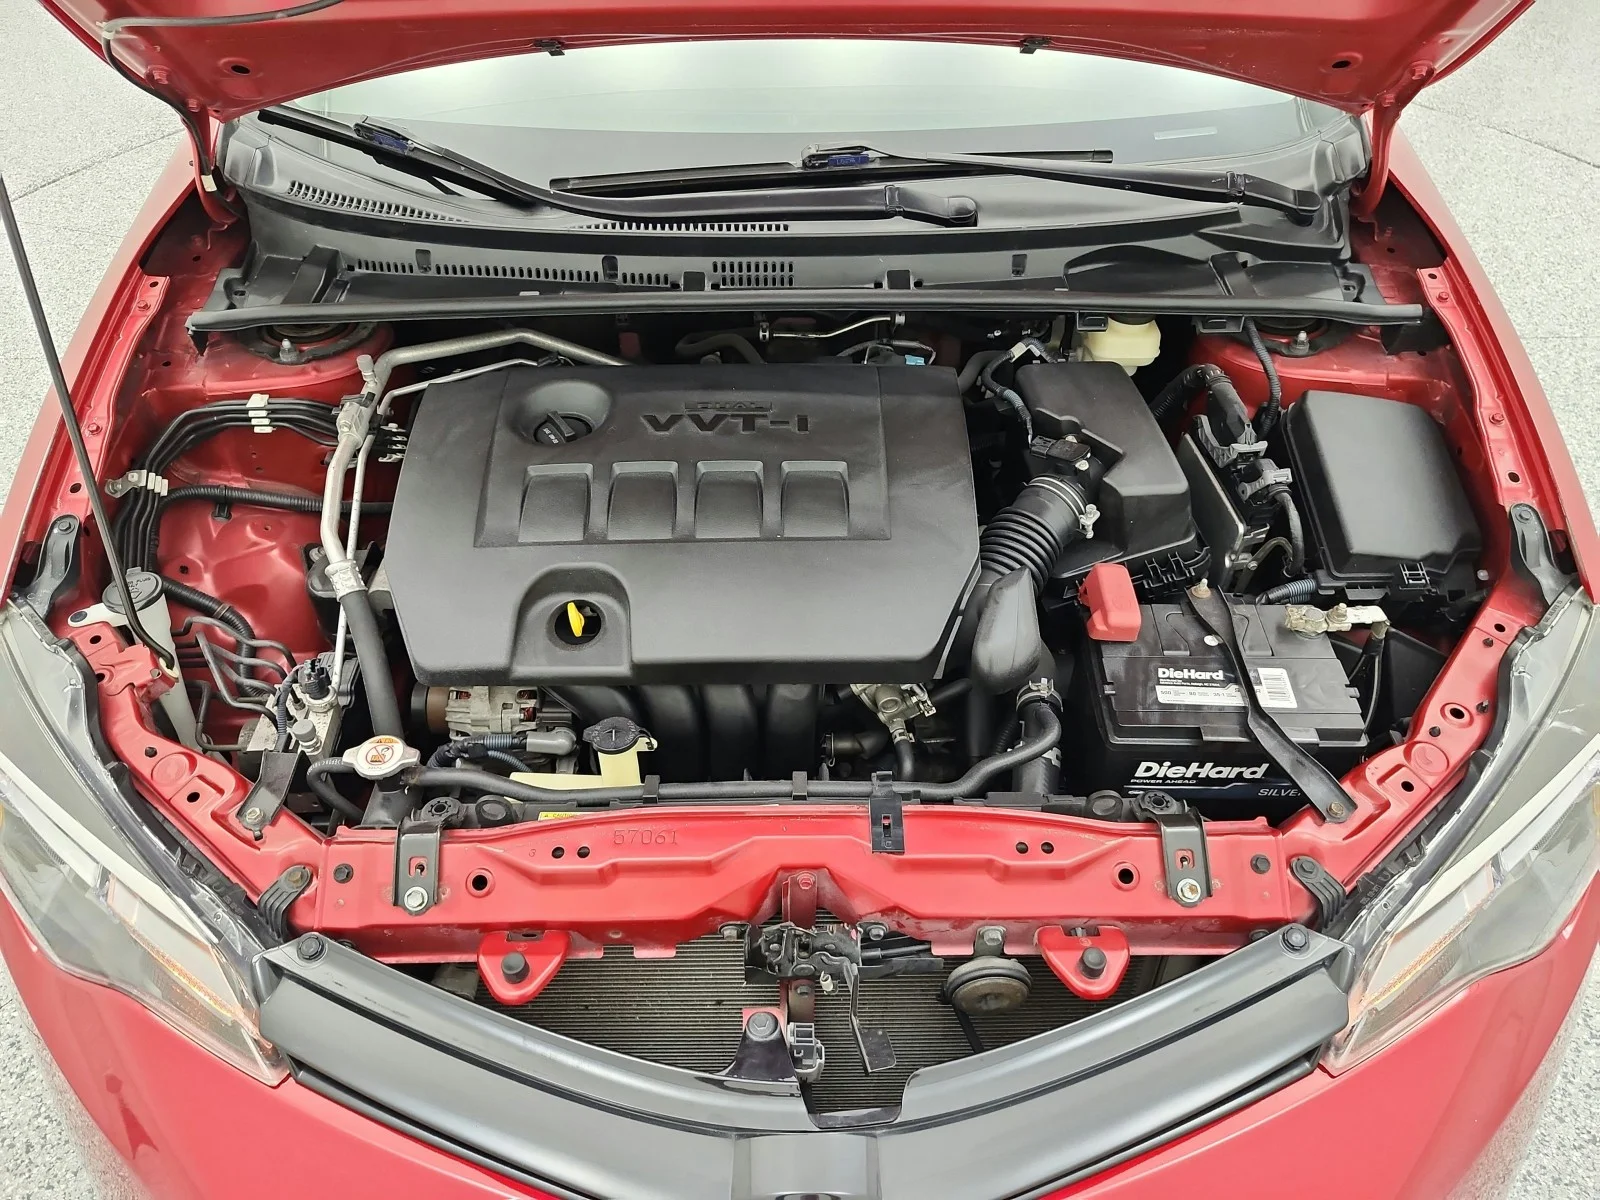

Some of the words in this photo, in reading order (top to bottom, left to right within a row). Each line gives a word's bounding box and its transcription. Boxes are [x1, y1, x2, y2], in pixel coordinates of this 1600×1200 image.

[1157, 667, 1225, 681] DieHard
[1134, 761, 1270, 779] DieHard
[1257, 788, 1301, 797] SILVE
[613, 829, 679, 846] 57061
